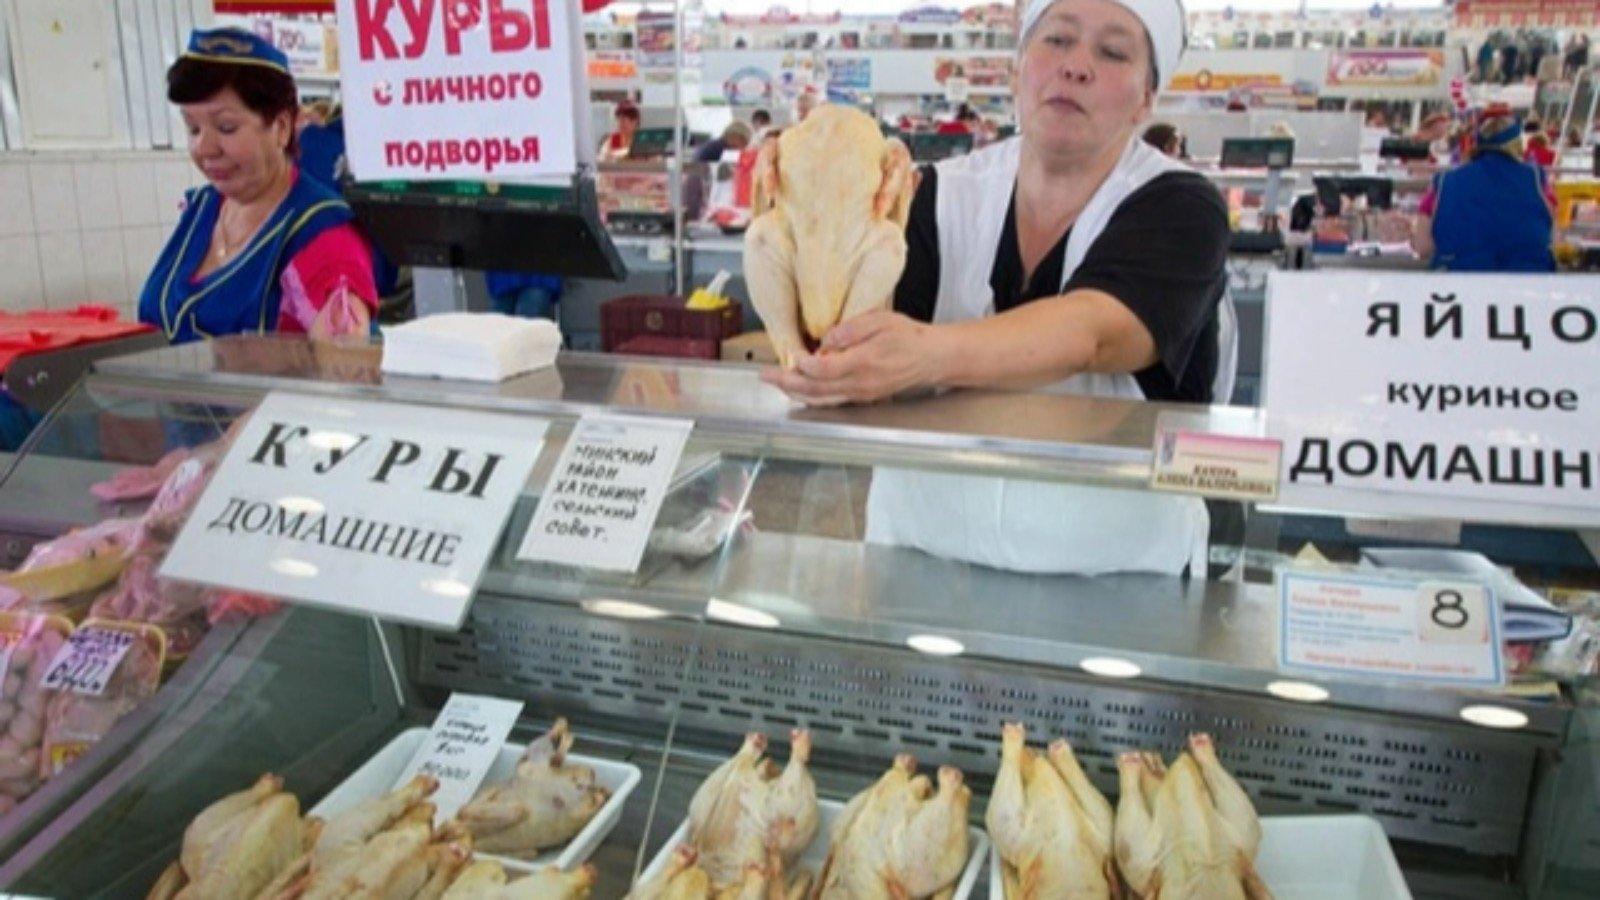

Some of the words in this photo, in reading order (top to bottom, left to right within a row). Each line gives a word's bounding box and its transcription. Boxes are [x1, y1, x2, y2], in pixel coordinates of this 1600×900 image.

[355, 0, 551, 61] КУРЫ
[402, 71, 542, 106] личного
[384, 136, 541, 174] подворья
[1366, 293, 1598, 350] ЯЙЦО
[1387, 381, 1579, 412] куриное
[249, 421, 505, 499] КУРЫ
[1289, 437, 1600, 490] ДОМАШН
[207, 497, 463, 567] ДОМАШНИЕ
[1431, 588, 1470, 630] 8
